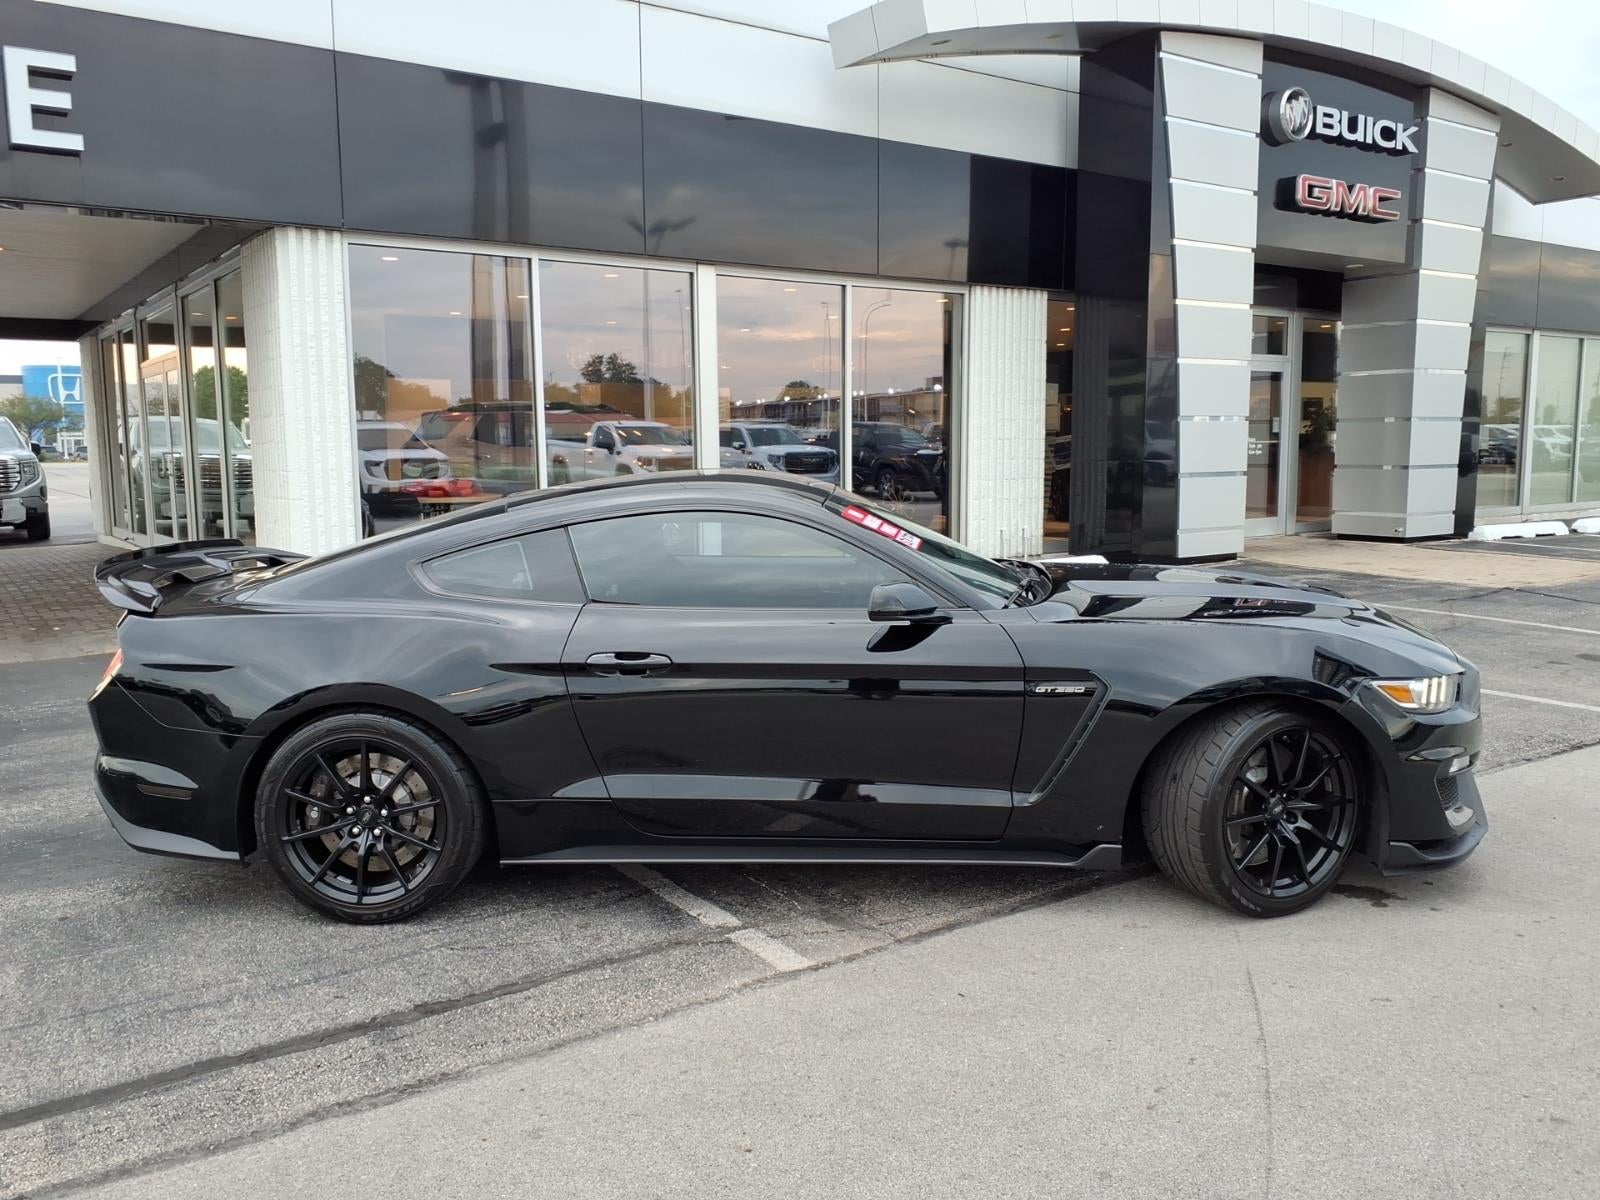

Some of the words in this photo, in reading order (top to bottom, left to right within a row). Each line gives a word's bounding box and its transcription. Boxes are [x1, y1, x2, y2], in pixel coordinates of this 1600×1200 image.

[3, 45, 85, 151] E
[1315, 104, 1419, 153] BUICK
[1296, 174, 1401, 220] GMC
